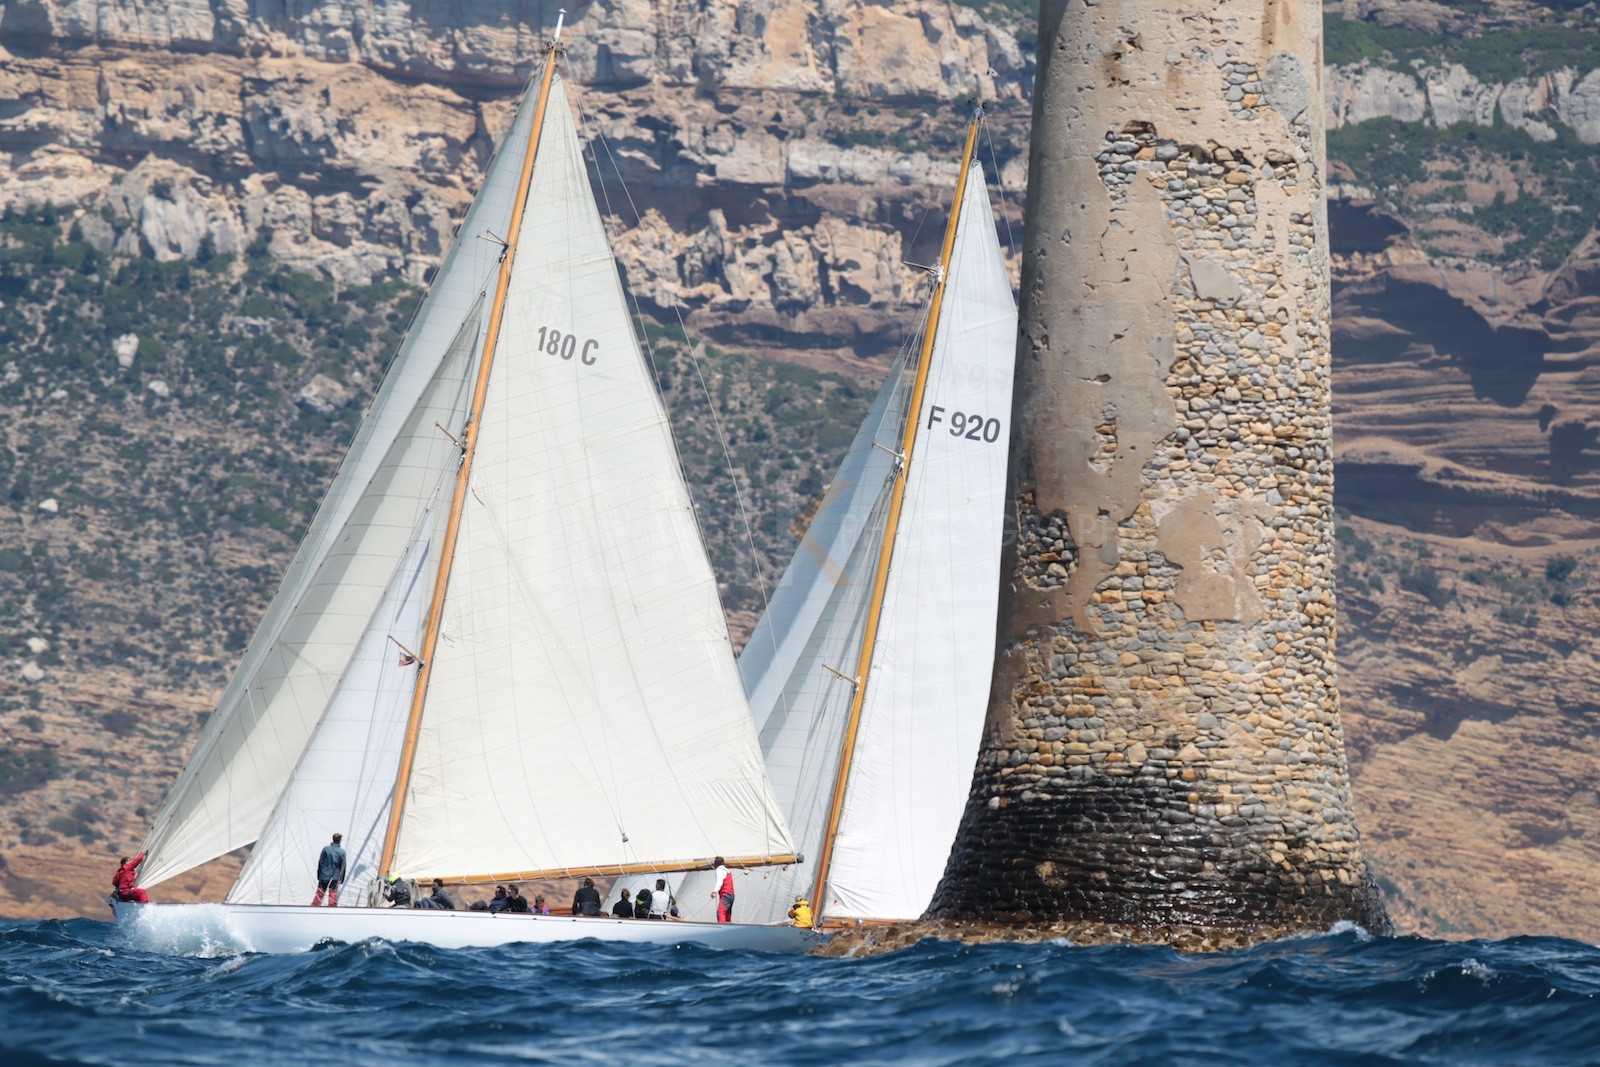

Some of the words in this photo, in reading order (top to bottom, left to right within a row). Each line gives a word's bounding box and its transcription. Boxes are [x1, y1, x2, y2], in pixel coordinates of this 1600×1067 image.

[538, 326, 576, 360] 180
[581, 338, 599, 366] C
[927, 405, 945, 430] F
[949, 411, 1001, 443] 920
